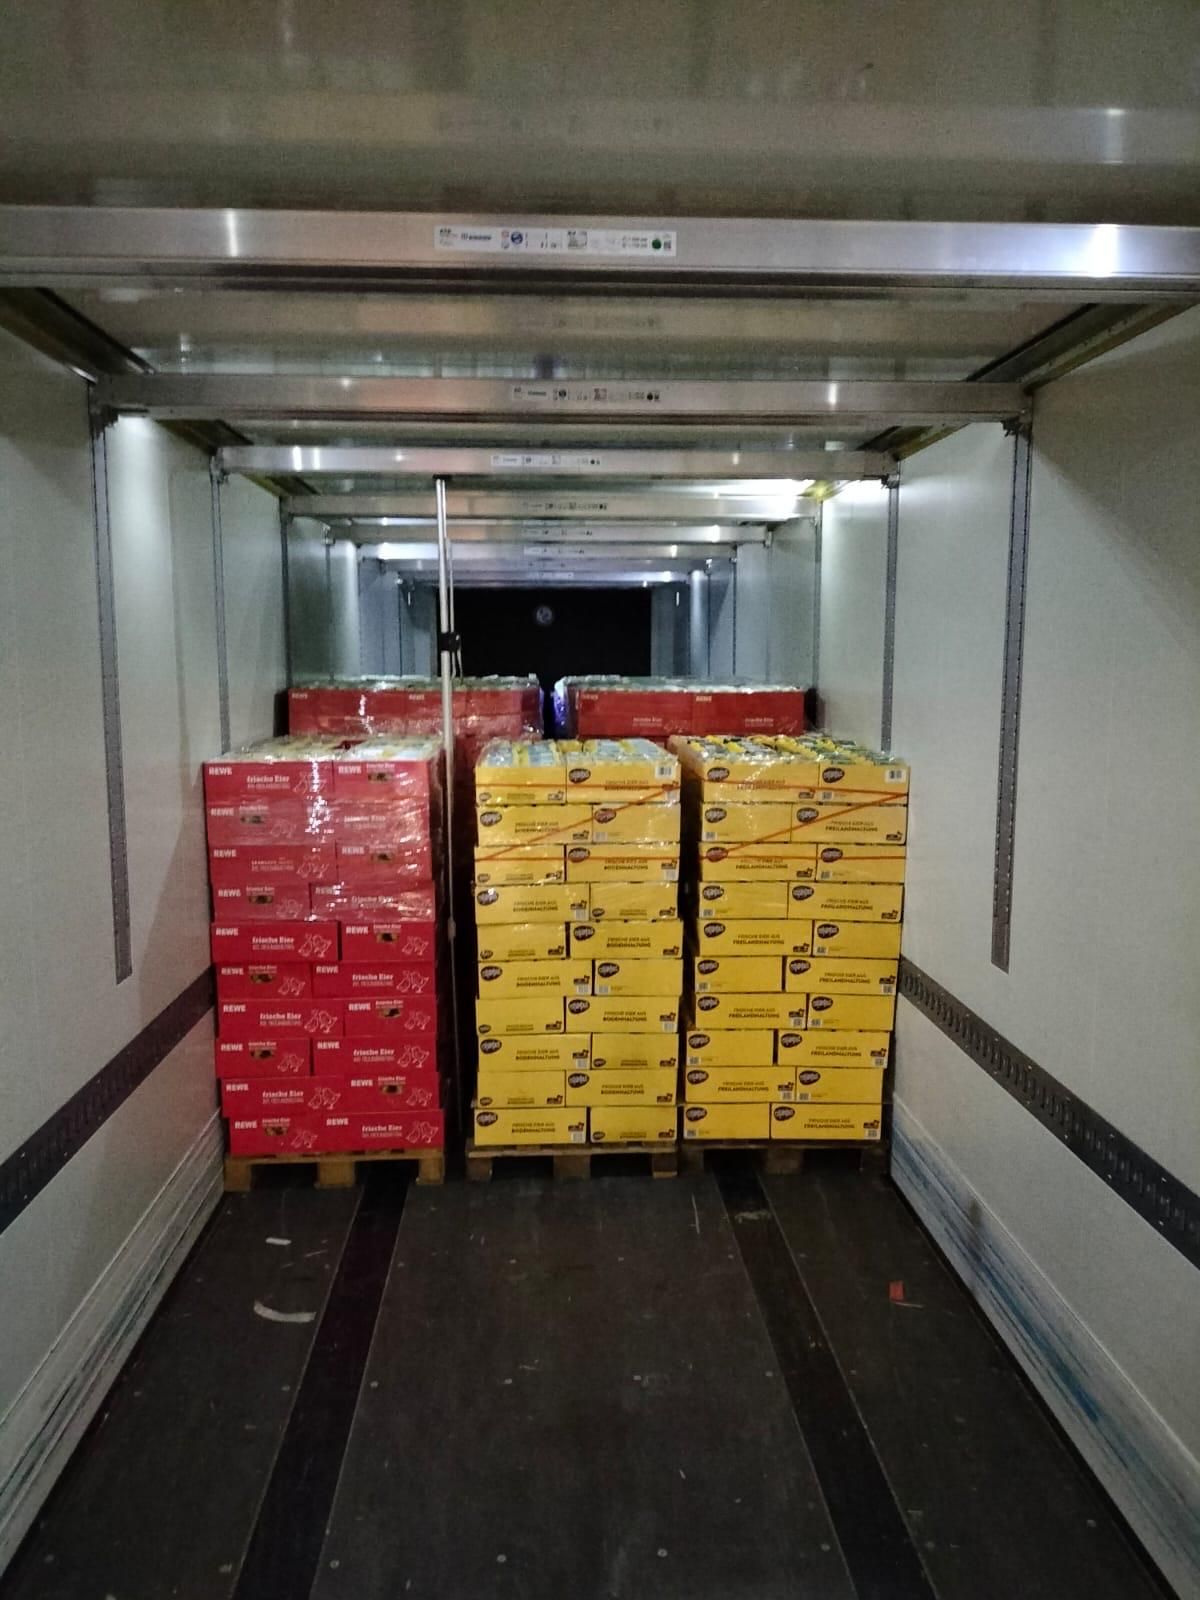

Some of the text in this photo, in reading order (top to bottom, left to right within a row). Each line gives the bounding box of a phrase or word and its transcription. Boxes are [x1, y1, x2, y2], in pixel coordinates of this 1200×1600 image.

[209, 767, 232, 775] REWE
[338, 766, 361, 774] REWE
[216, 928, 238, 936] REWE
[346, 926, 368, 934] REWE
[223, 1004, 246, 1012] REWE
[348, 1003, 370, 1011] REWE
[235, 1121, 257, 1129] REWE
[326, 1118, 348, 1126] REWE
